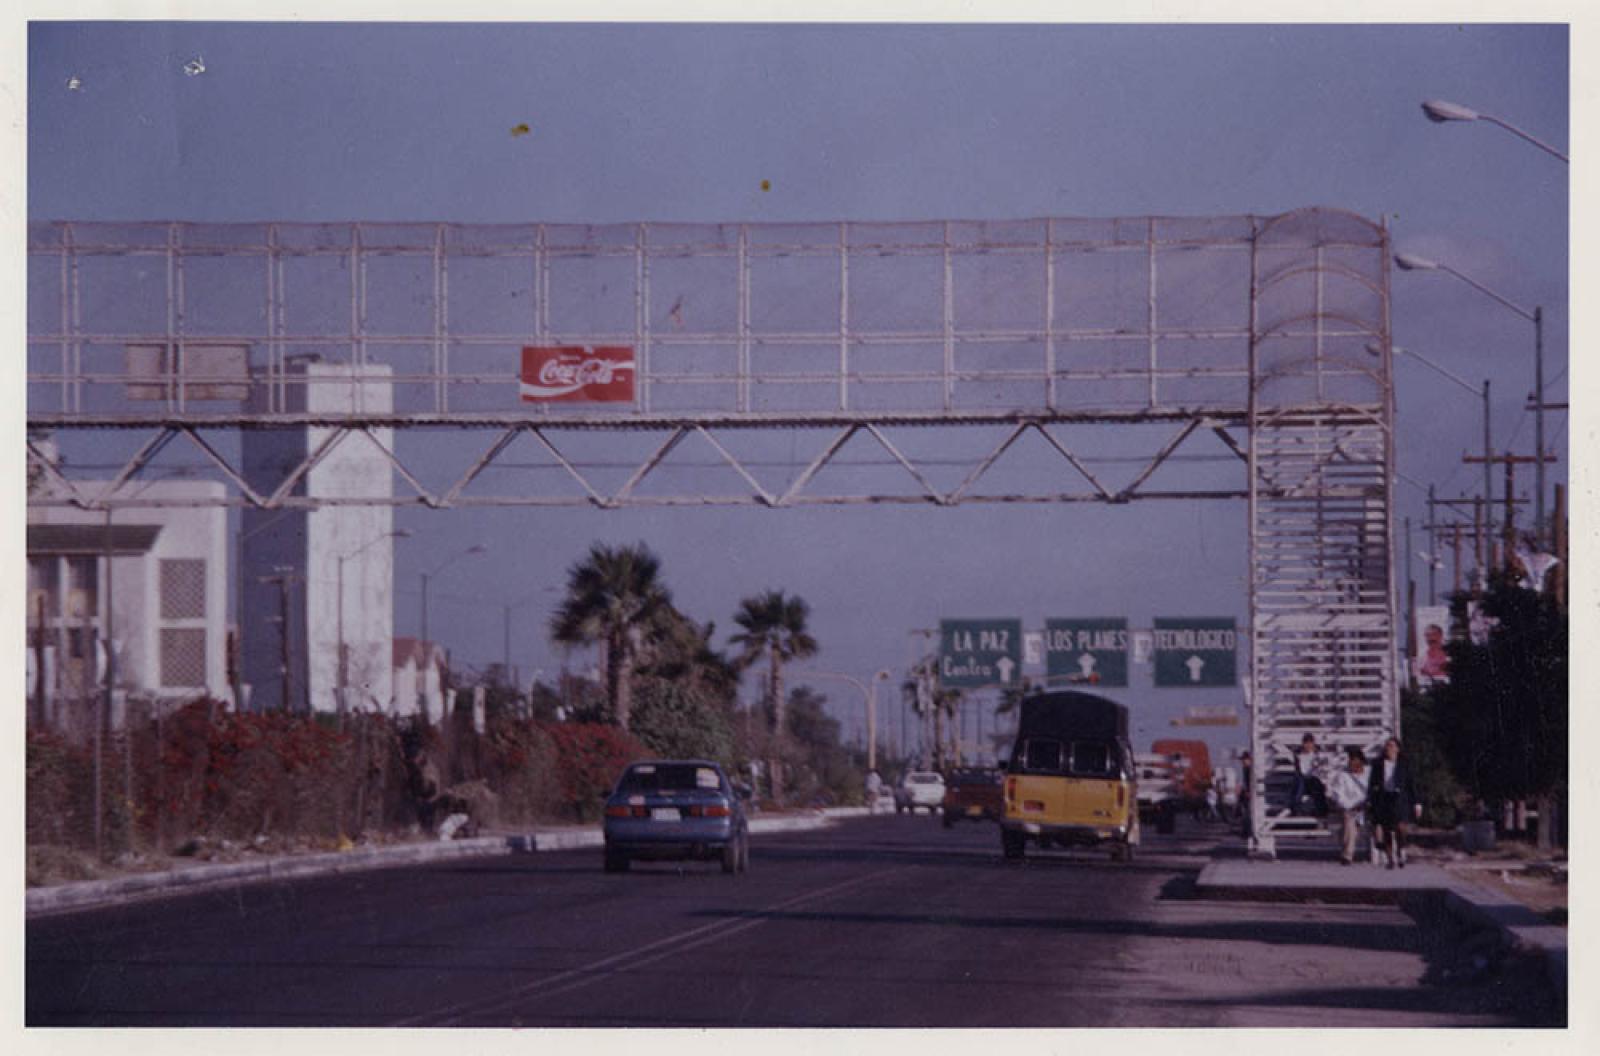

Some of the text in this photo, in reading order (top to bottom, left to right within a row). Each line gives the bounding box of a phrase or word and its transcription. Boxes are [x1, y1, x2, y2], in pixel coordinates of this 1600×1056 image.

[953, 630, 1009, 652] LA PAZ
[1047, 629, 1128, 651] LOS PLANES
[1153, 629, 1236, 651] TECNOLOGICO
[943, 656, 992, 677] Centro
